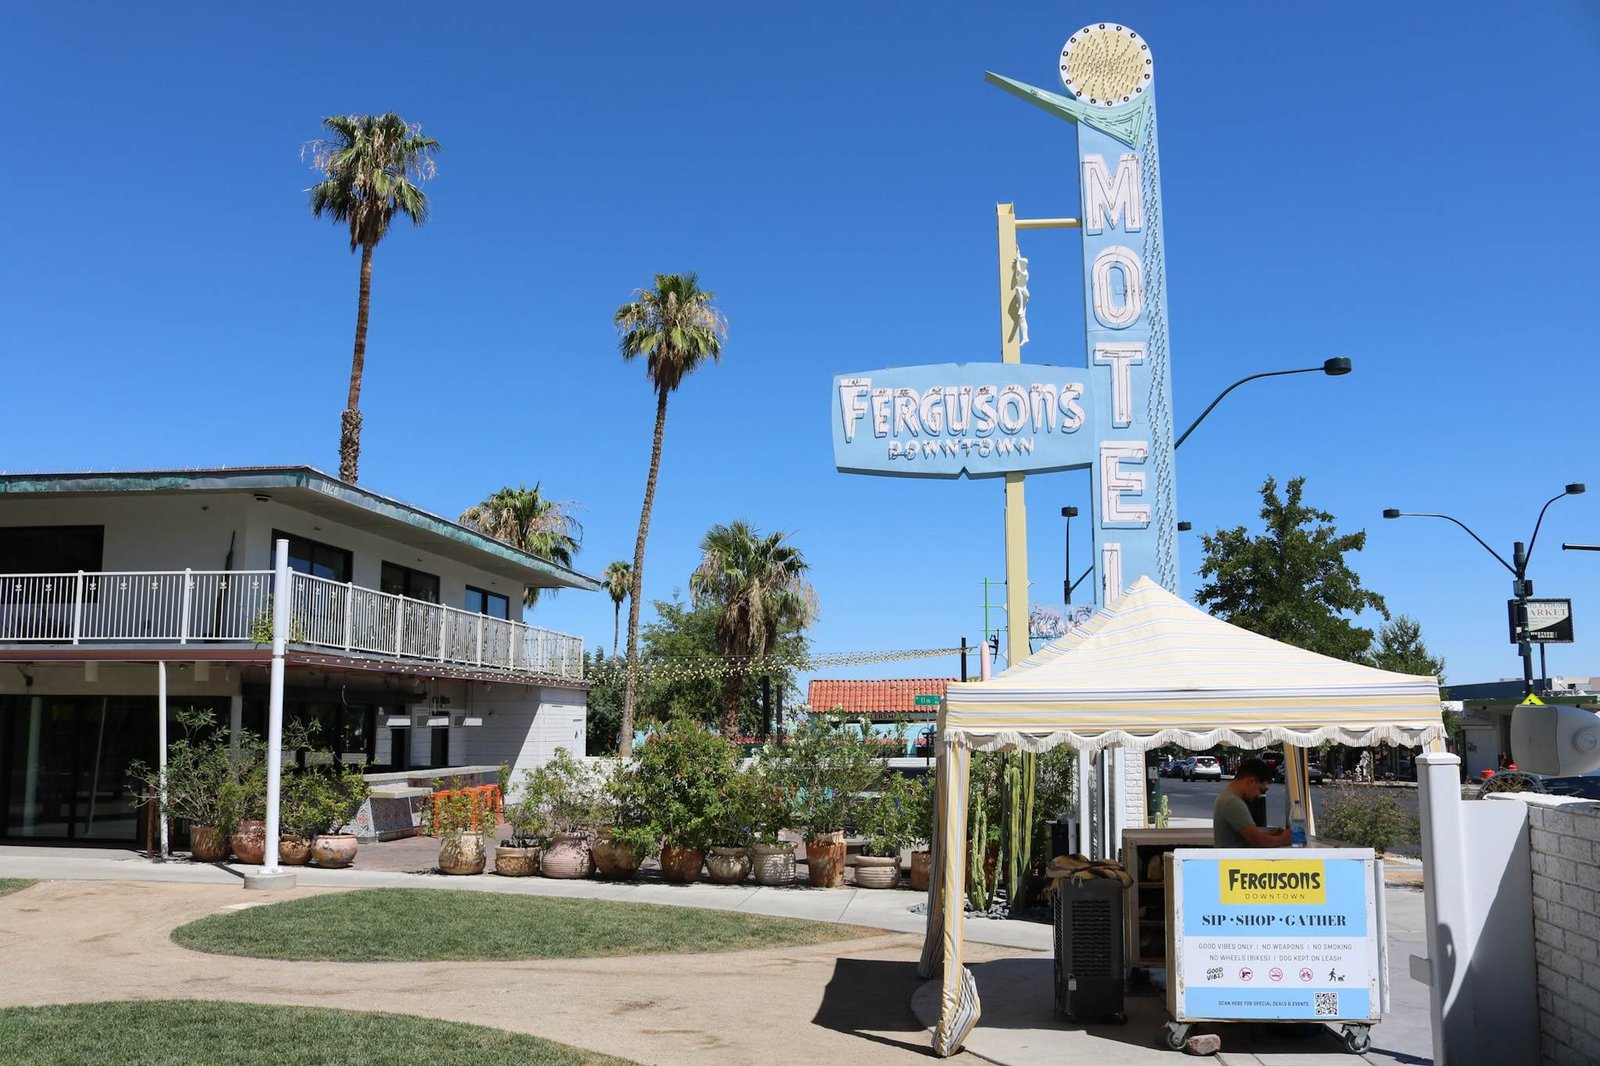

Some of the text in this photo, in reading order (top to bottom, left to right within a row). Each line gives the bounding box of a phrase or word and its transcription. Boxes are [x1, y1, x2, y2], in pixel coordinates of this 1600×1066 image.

[839, 378, 1085, 443] FERGUSONS
[888, 437, 1034, 460] DOWNTOWN
[1228, 869, 1321, 891] FERGUSONS
[1202, 914, 1346, 926] SIP SHOP GATHER
[1206, 967, 1224, 975] GOOD
